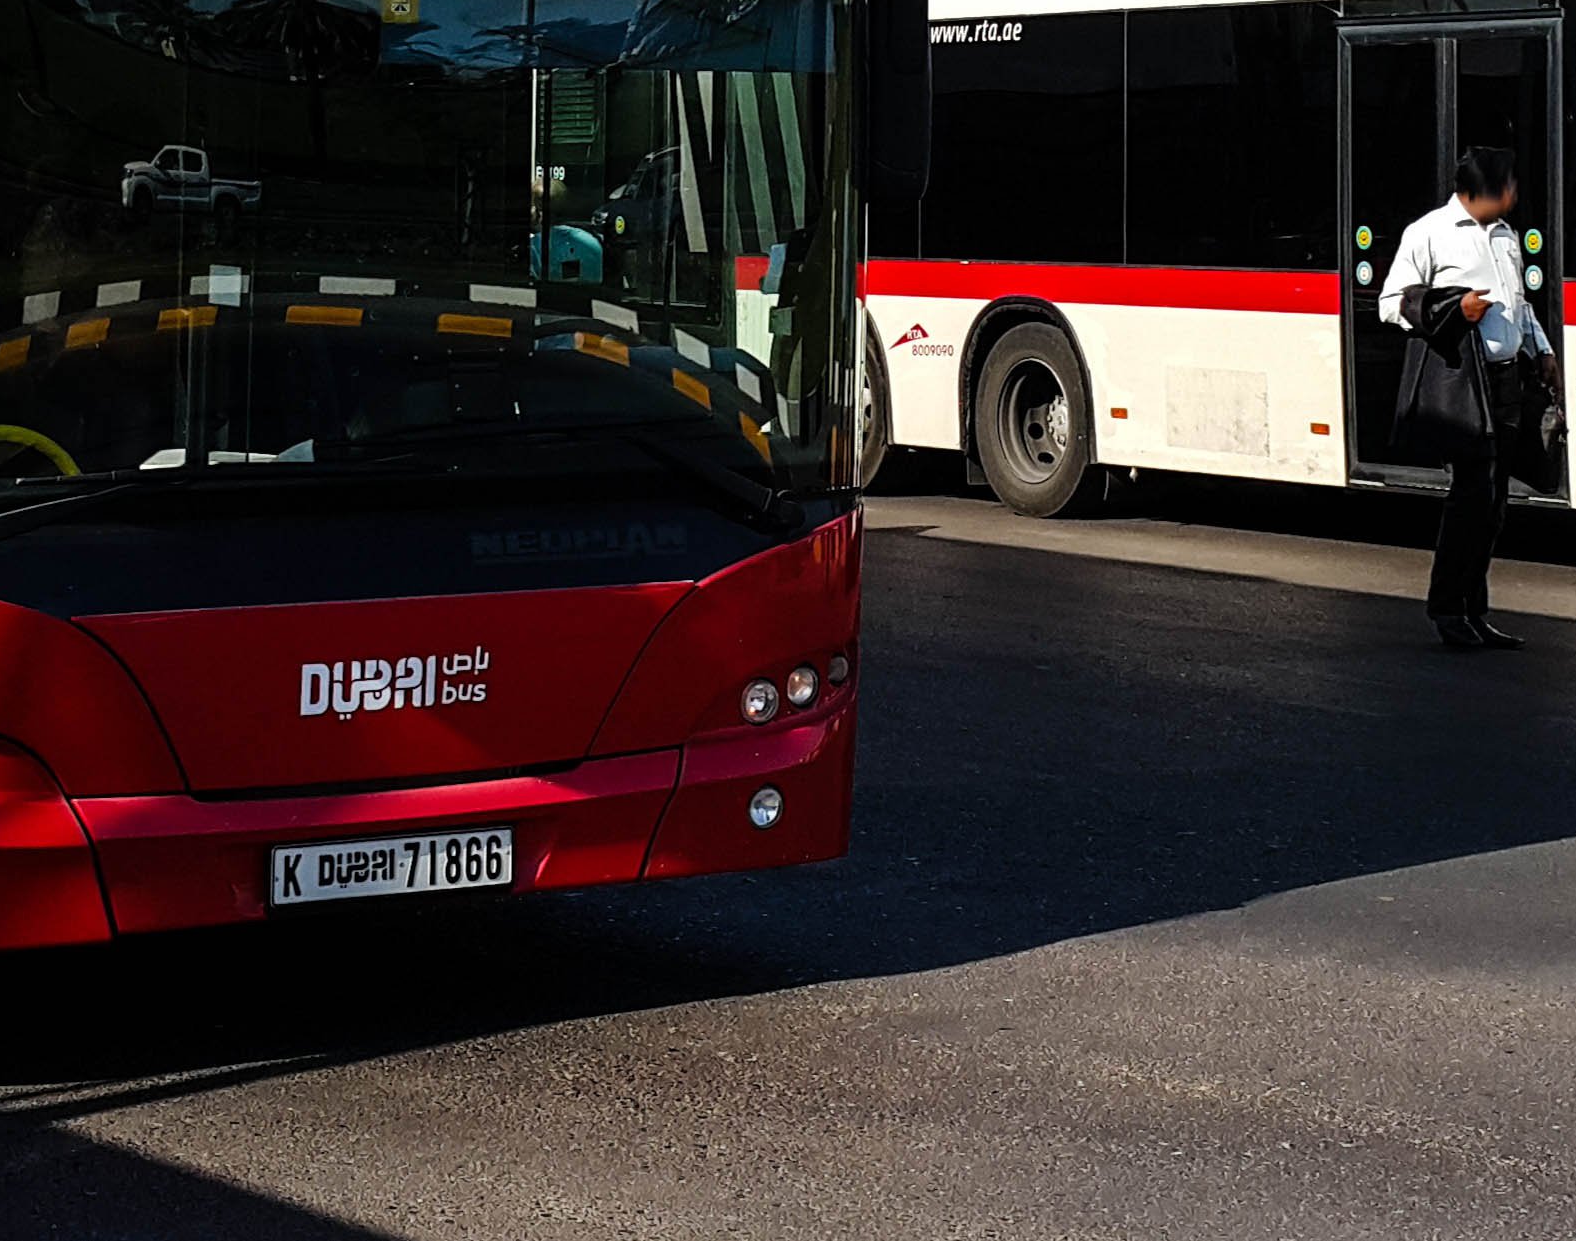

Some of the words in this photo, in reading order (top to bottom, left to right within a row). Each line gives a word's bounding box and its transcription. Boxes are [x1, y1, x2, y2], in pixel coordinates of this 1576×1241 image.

[930, 20, 1023, 44] www.rta.ae
[536, 165, 565, 180] E199
[907, 328, 924, 340] RTA
[912, 345, 954, 356] 8009090
[442, 646, 490, 675] باص
[300, 655, 437, 720] DUBAI
[441, 680, 487, 705] bus
[283, 853, 302, 898] K
[318, 848, 396, 888] DUBAI
[404, 835, 502, 888] 71866
